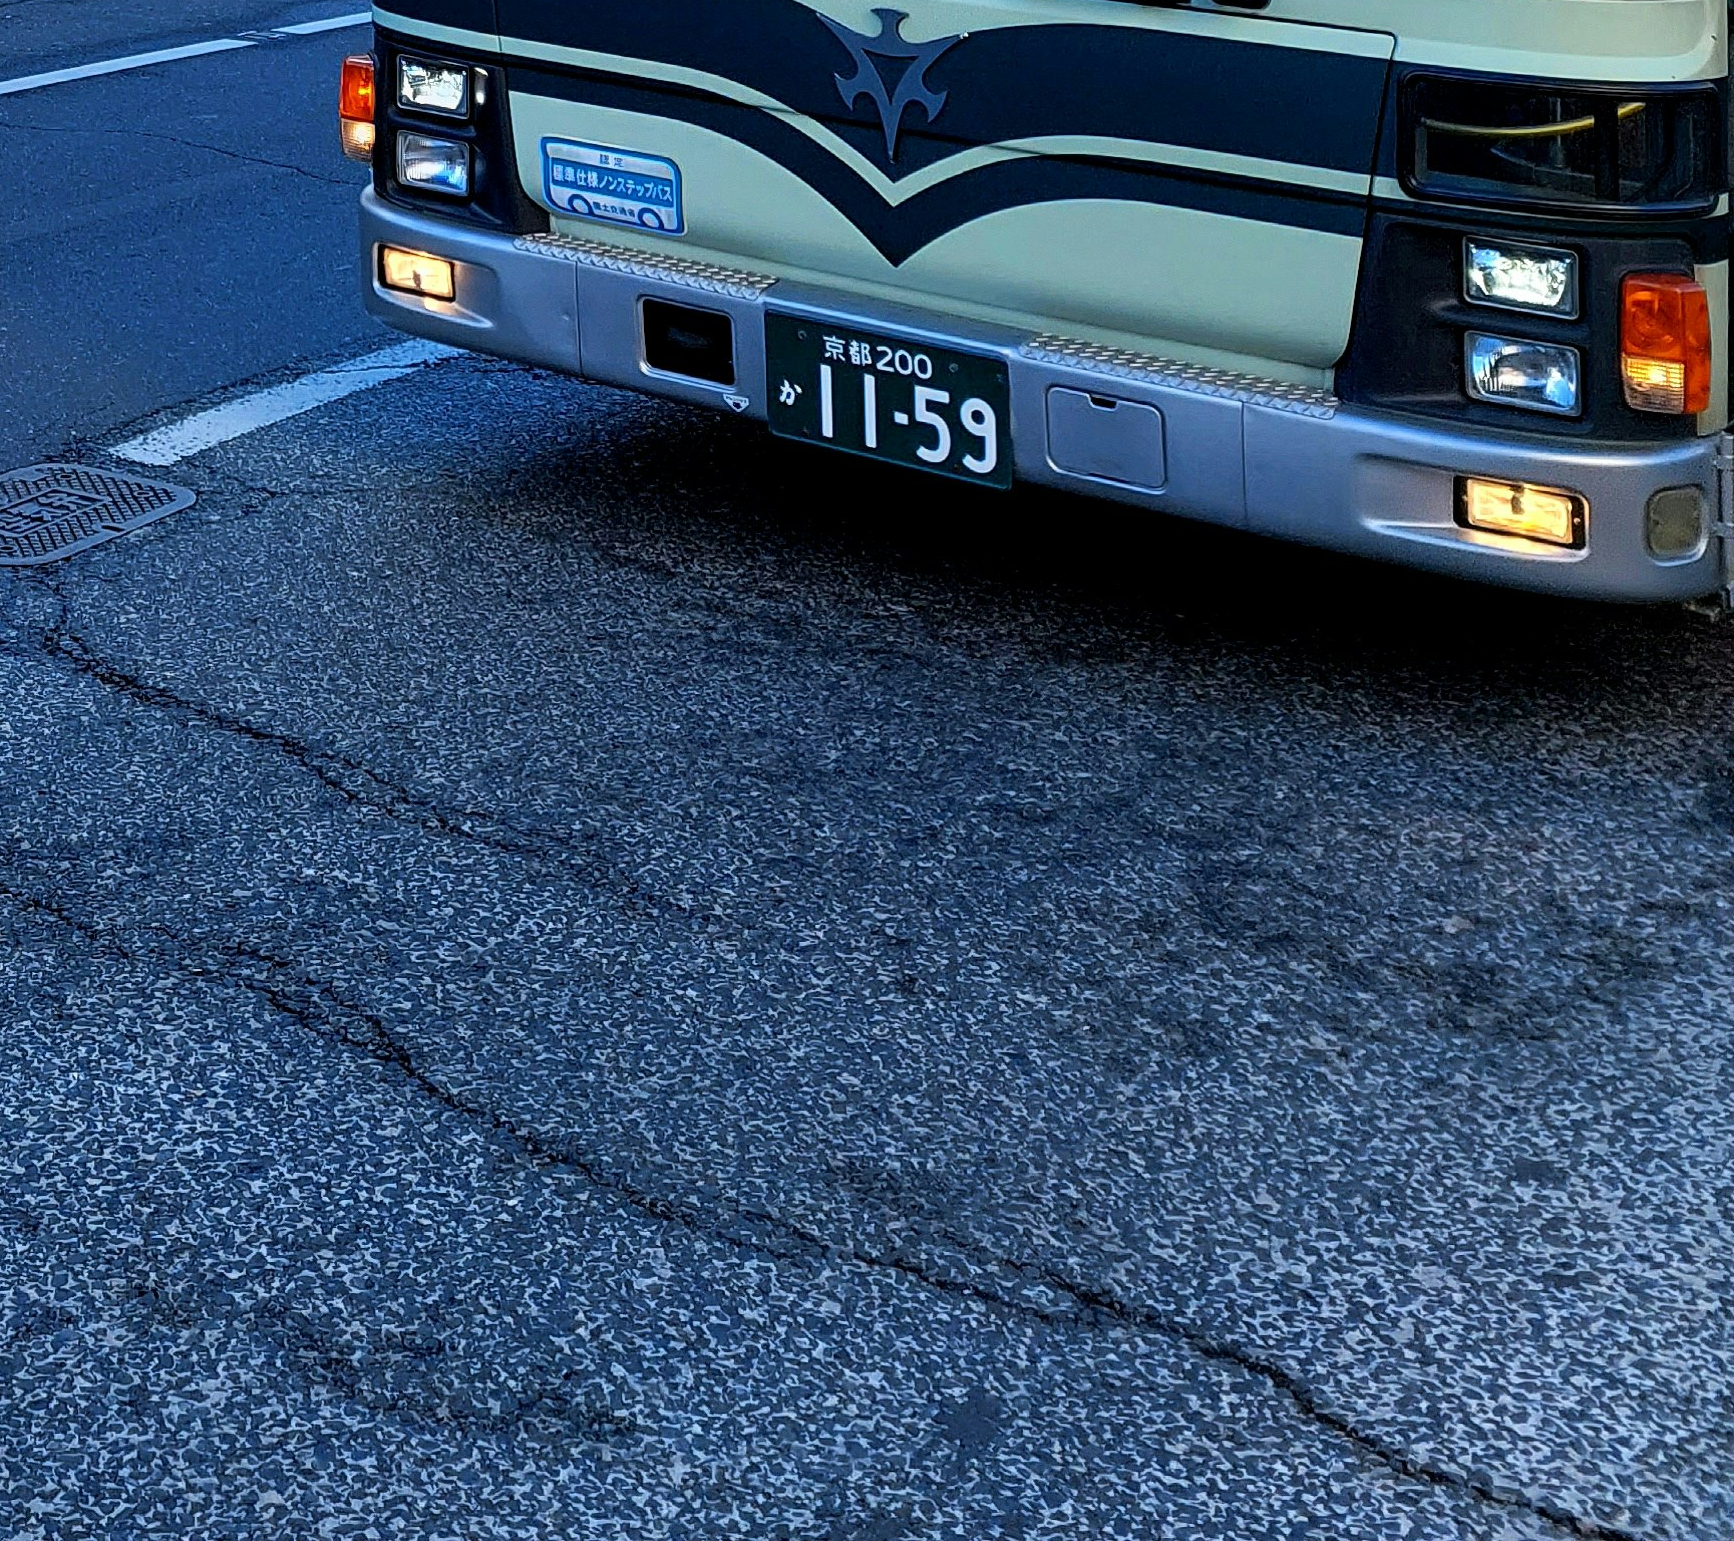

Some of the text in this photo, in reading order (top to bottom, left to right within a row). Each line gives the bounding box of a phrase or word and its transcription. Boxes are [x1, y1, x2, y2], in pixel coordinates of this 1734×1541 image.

[553, 163, 673, 202] 標準仕様ノンステップバス
[779, 363, 998, 474] か 11-59
